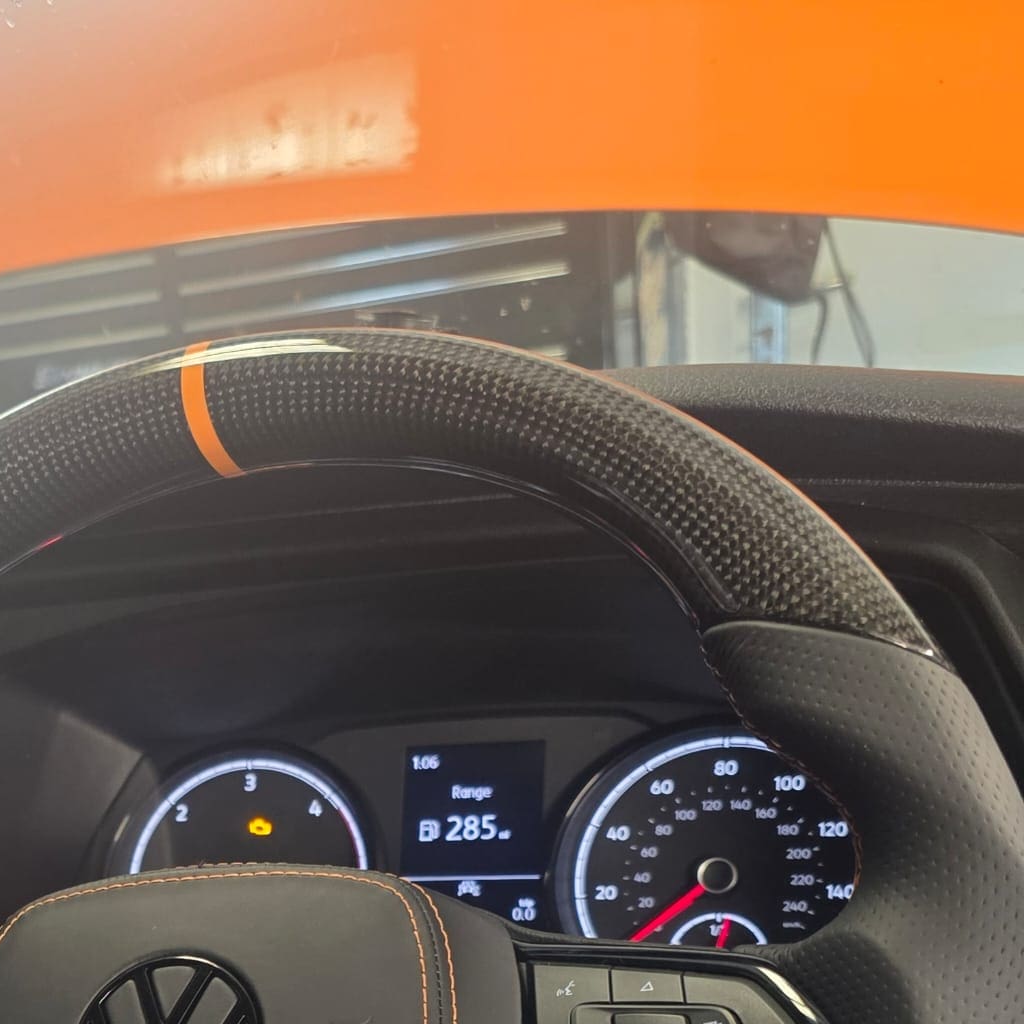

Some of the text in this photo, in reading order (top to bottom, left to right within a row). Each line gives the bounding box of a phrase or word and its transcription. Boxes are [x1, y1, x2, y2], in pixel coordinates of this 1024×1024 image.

[713, 760, 739, 776] 80
[244, 773, 257, 792] 3
[650, 779, 674, 795] 60
[774, 775, 805, 792] 100
[451, 784, 494, 801] Range
[308, 800, 323, 817] 4
[702, 800, 722, 811] 120
[730, 799, 752, 811] 140
[176, 804, 189, 822] 2
[675, 809, 697, 821] 100
[755, 808, 777, 819] 160
[445, 814, 497, 841] 285
[606, 825, 630, 841] 40
[655, 825, 673, 836] 80
[777, 825, 799, 836] 180
[817, 821, 848, 837] 120
[640, 847, 658, 858] 60
[786, 848, 812, 860] 200
[633, 872, 652, 884] 40
[790, 874, 815, 886] 220
[595, 885, 618, 901] 20
[825, 884, 855, 900] 140
[638, 897, 655, 908] 20
[782, 900, 808, 912] 240
[512, 907, 536, 921] 0.0
